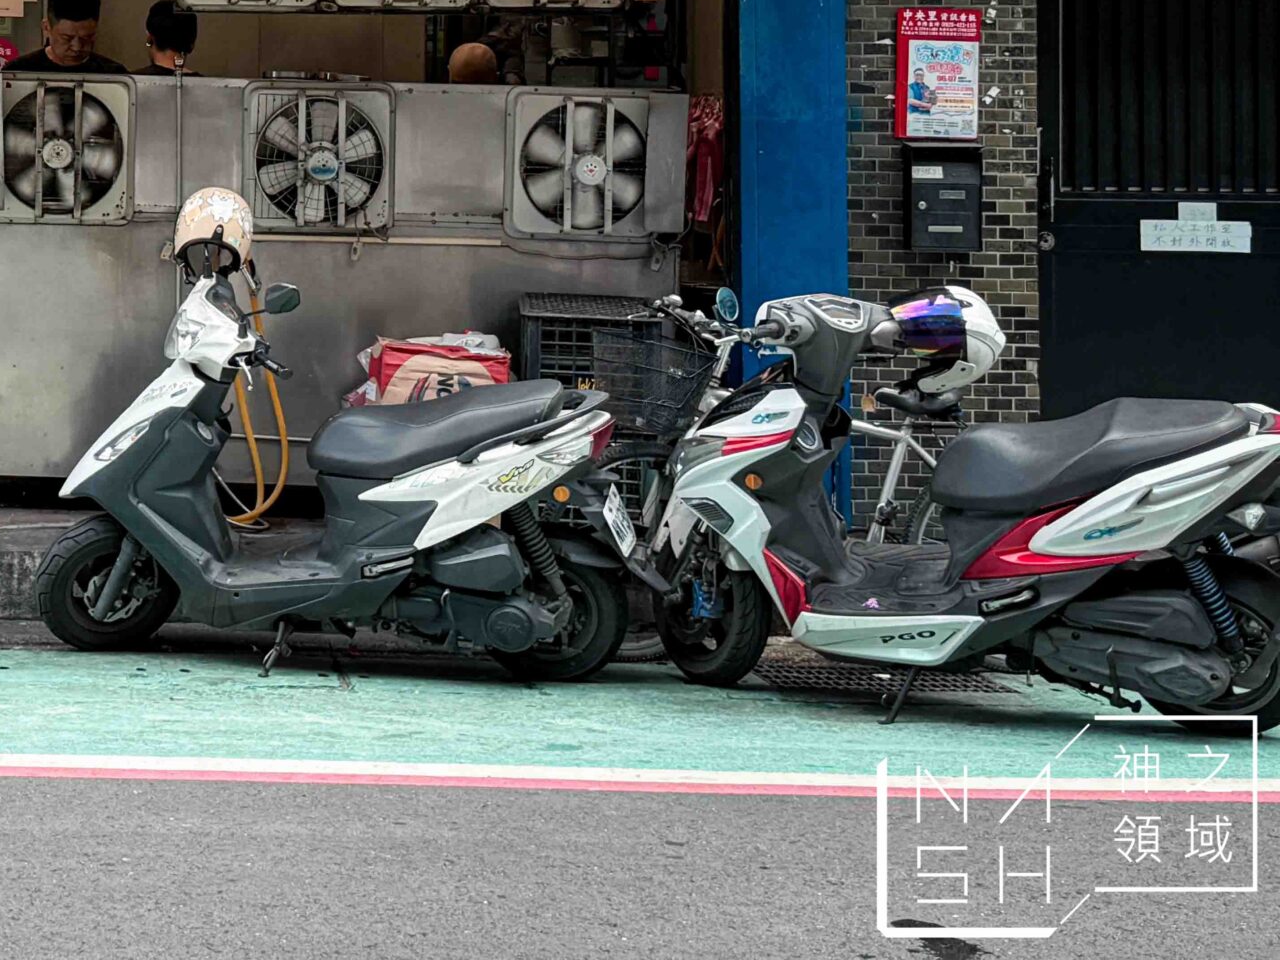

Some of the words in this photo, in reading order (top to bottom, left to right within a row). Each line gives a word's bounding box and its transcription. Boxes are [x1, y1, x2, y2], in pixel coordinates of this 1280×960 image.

[903, 8, 938, 21] 中央里
[879, 630, 937, 644] PGO
